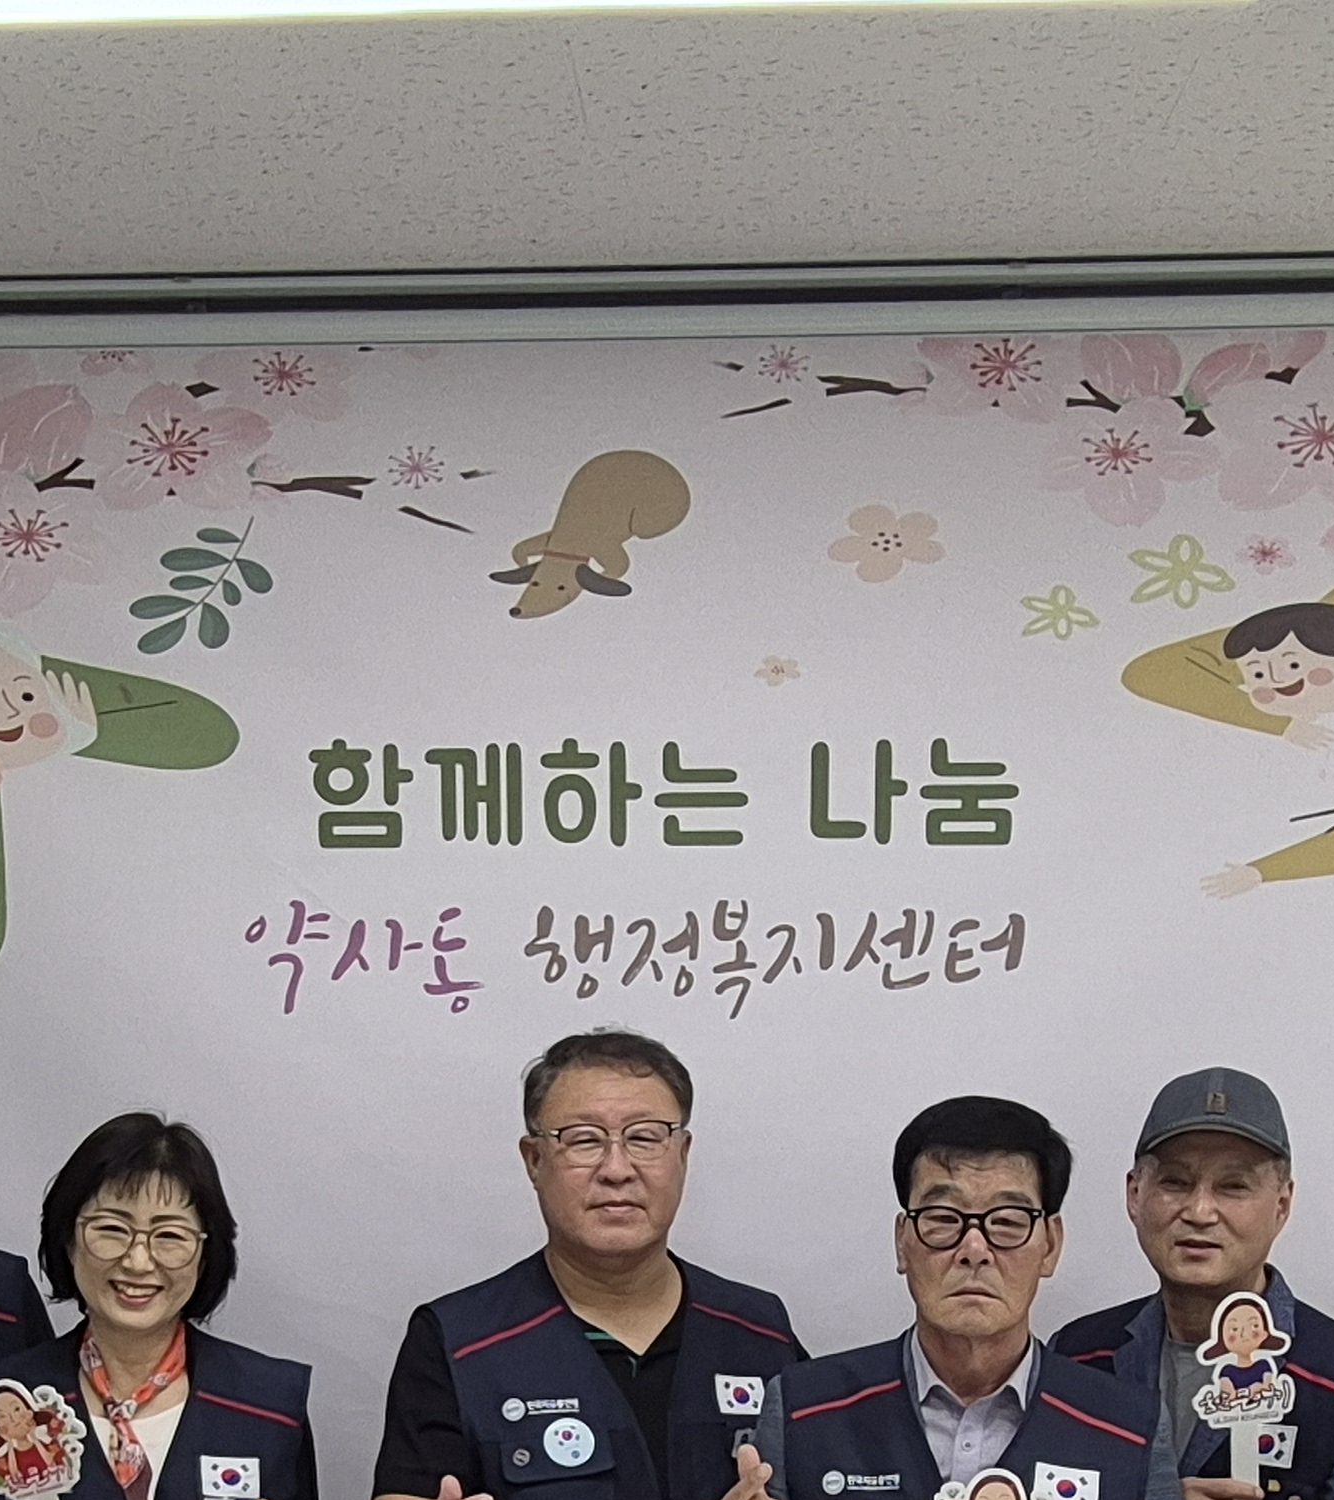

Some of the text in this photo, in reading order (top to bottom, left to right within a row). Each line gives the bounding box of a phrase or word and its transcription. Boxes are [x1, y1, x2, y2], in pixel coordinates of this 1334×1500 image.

[307, 737, 1021, 849] 함께하는 나눔
[243, 898, 1027, 1021] 약사동 행정복지센터
